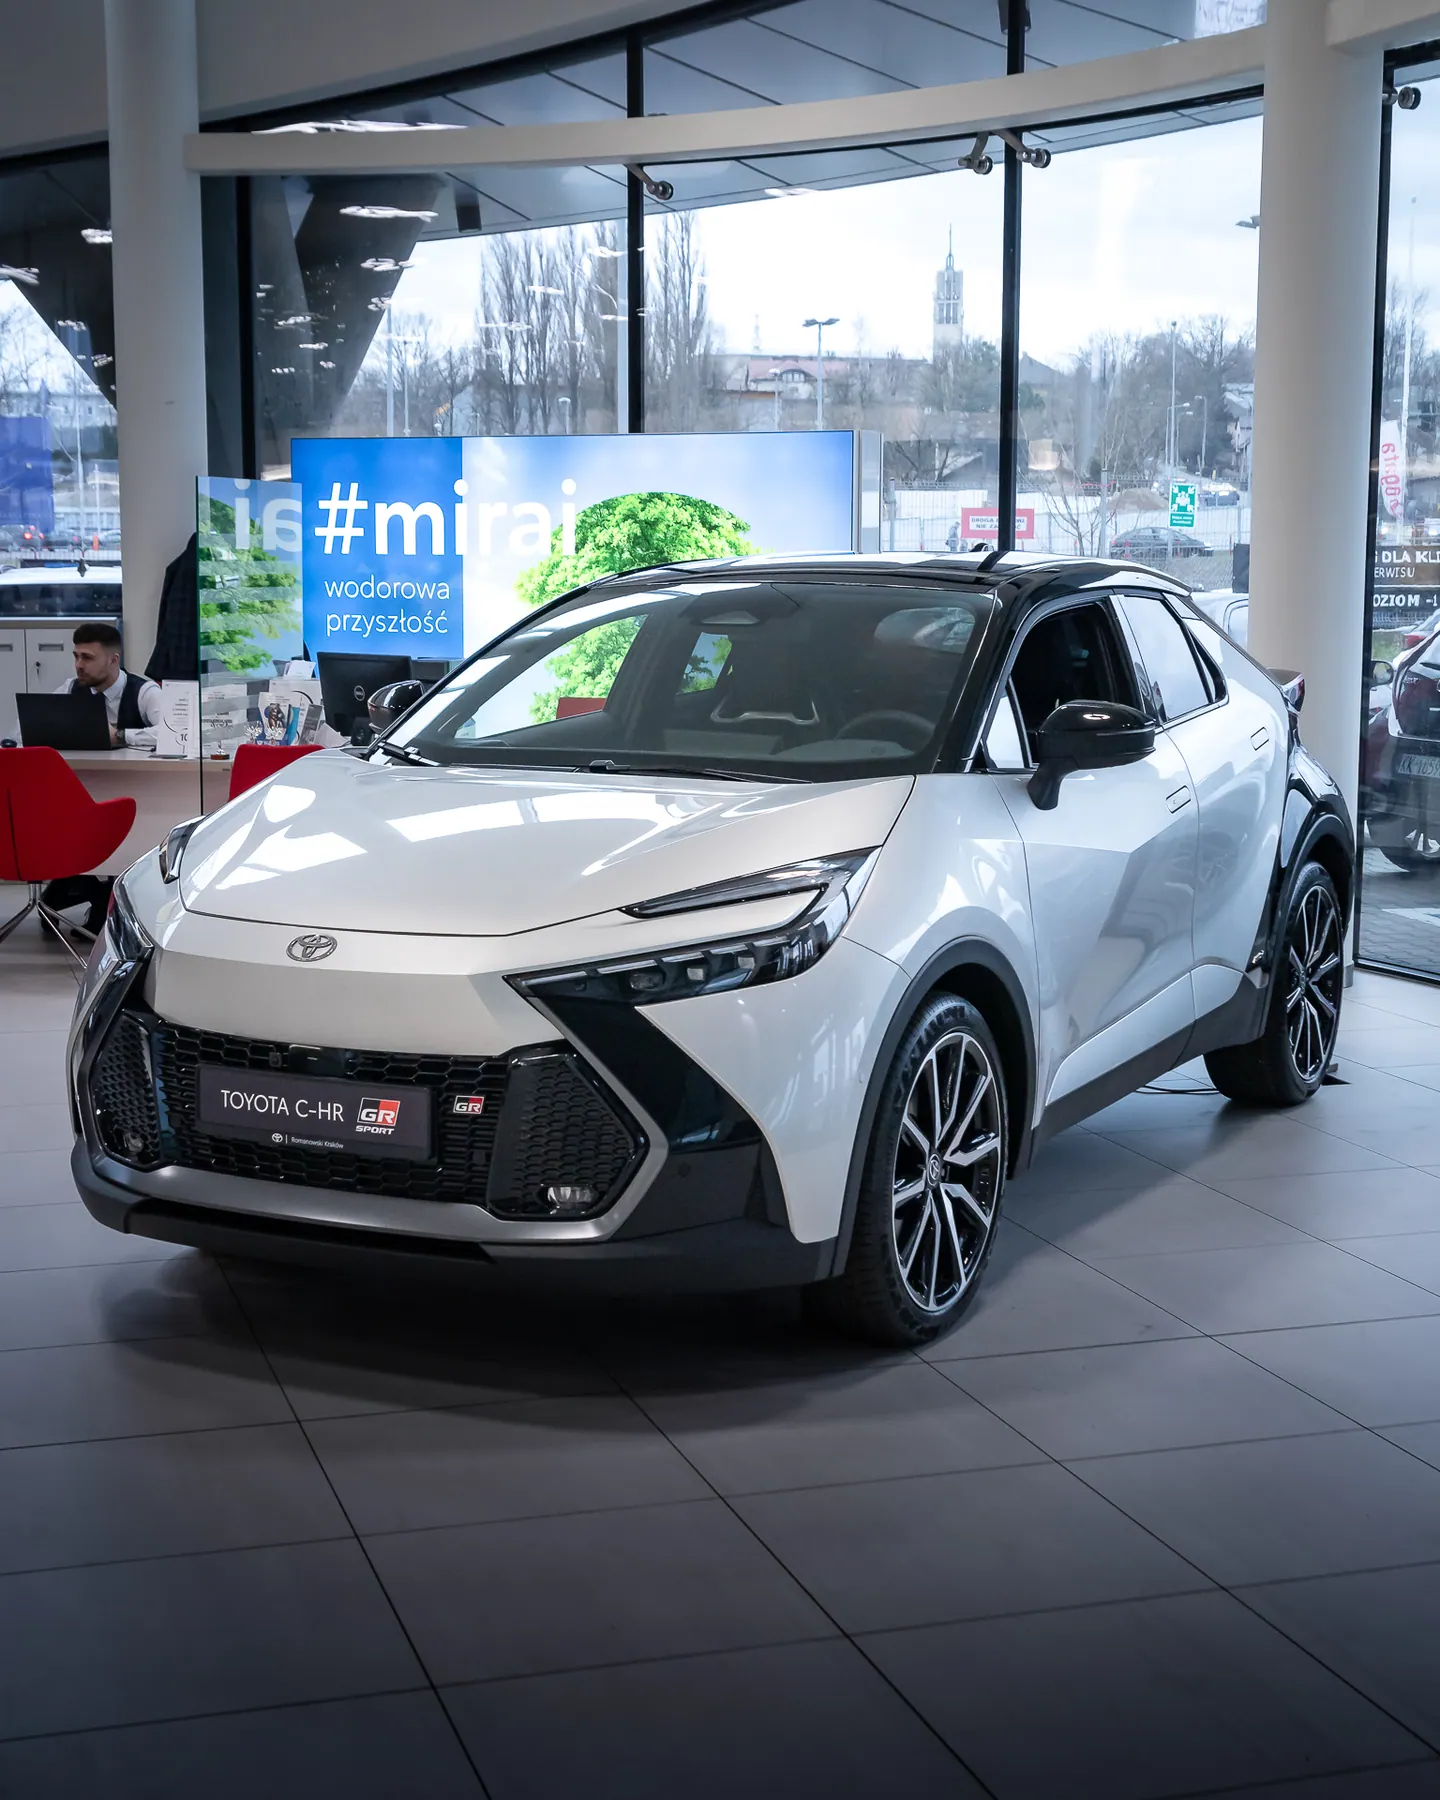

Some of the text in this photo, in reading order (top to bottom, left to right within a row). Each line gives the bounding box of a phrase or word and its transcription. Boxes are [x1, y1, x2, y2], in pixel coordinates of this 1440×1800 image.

[314, 479, 577, 556] #mirai
[1382, 551, 1411, 563] DLA
[1374, 566, 1415, 578] ERWISU
[324, 575, 450, 600] wodorowa
[1373, 594, 1438, 607] OZIOM -1
[326, 609, 449, 639] przyszłość
[220, 1089, 344, 1122] TOYOTA C-HR
[455, 1102, 481, 1113] GR
[360, 1108, 396, 1124] GR
[355, 1125, 395, 1135] SPORT
[291, 1136, 323, 1146] Romanowski
